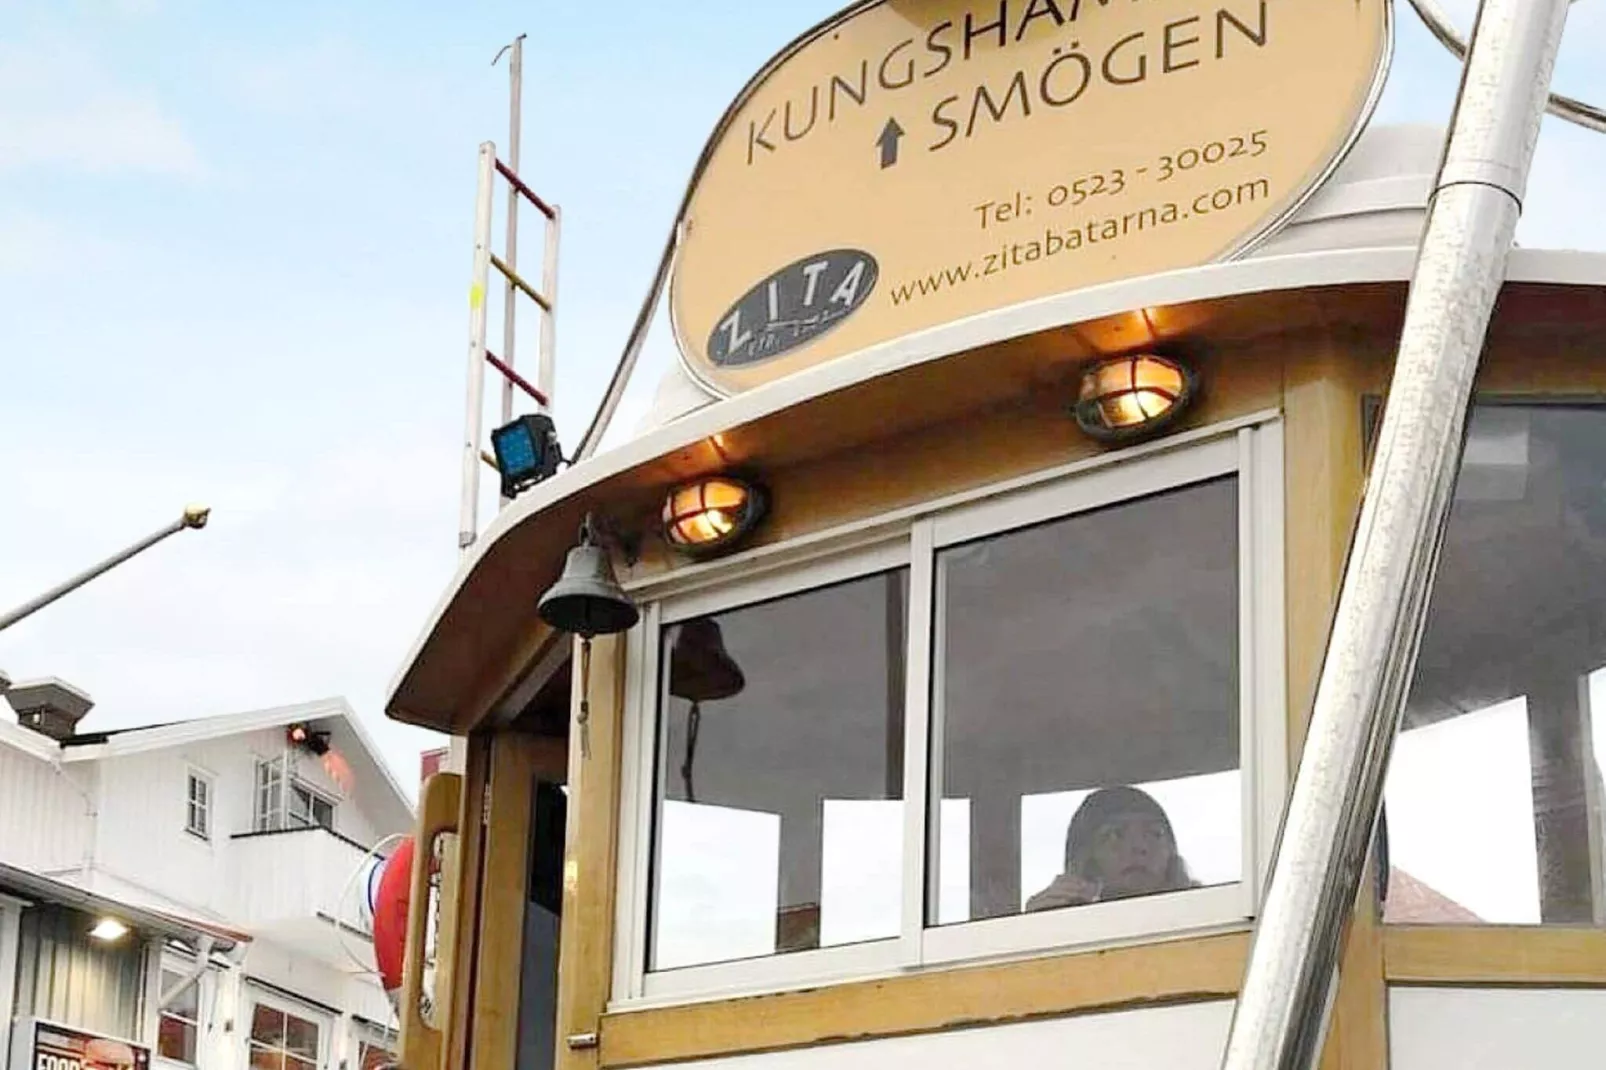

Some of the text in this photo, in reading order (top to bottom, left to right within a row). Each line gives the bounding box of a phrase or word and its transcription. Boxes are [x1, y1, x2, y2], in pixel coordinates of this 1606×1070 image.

[928, 0, 1268, 152] SMÖGEN
[974, 192, 1033, 230] Tel:
[1047, 169, 1125, 207] 0523
[1156, 130, 1268, 182] 30025
[890, 177, 1270, 306] www.zitabatarna.com
[720, 260, 866, 354] ZITA
